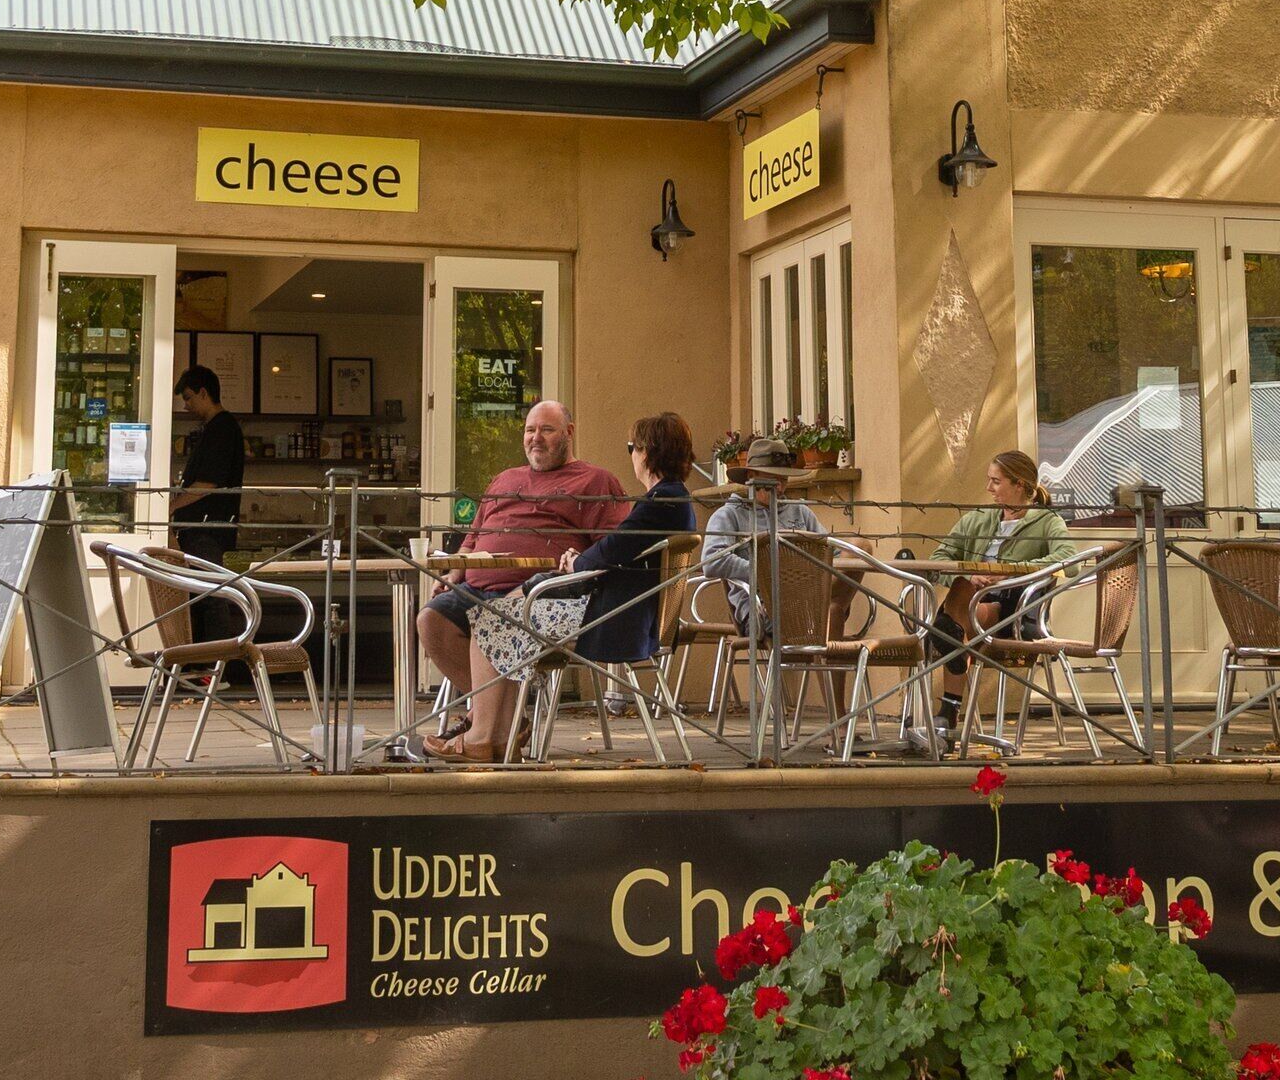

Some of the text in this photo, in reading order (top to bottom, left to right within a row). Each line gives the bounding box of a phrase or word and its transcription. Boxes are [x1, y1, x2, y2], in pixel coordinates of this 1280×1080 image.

[215, 143, 401, 198] cheese
[749, 141, 813, 203] cheese
[478, 359, 517, 375] EAT
[478, 376, 517, 388] LOCAL
[371, 847, 502, 900] UDDER
[371, 909, 550, 962] DELIGHTS
[611, 861, 833, 957] Che
[369, 967, 548, 999] Cheese Cellar
